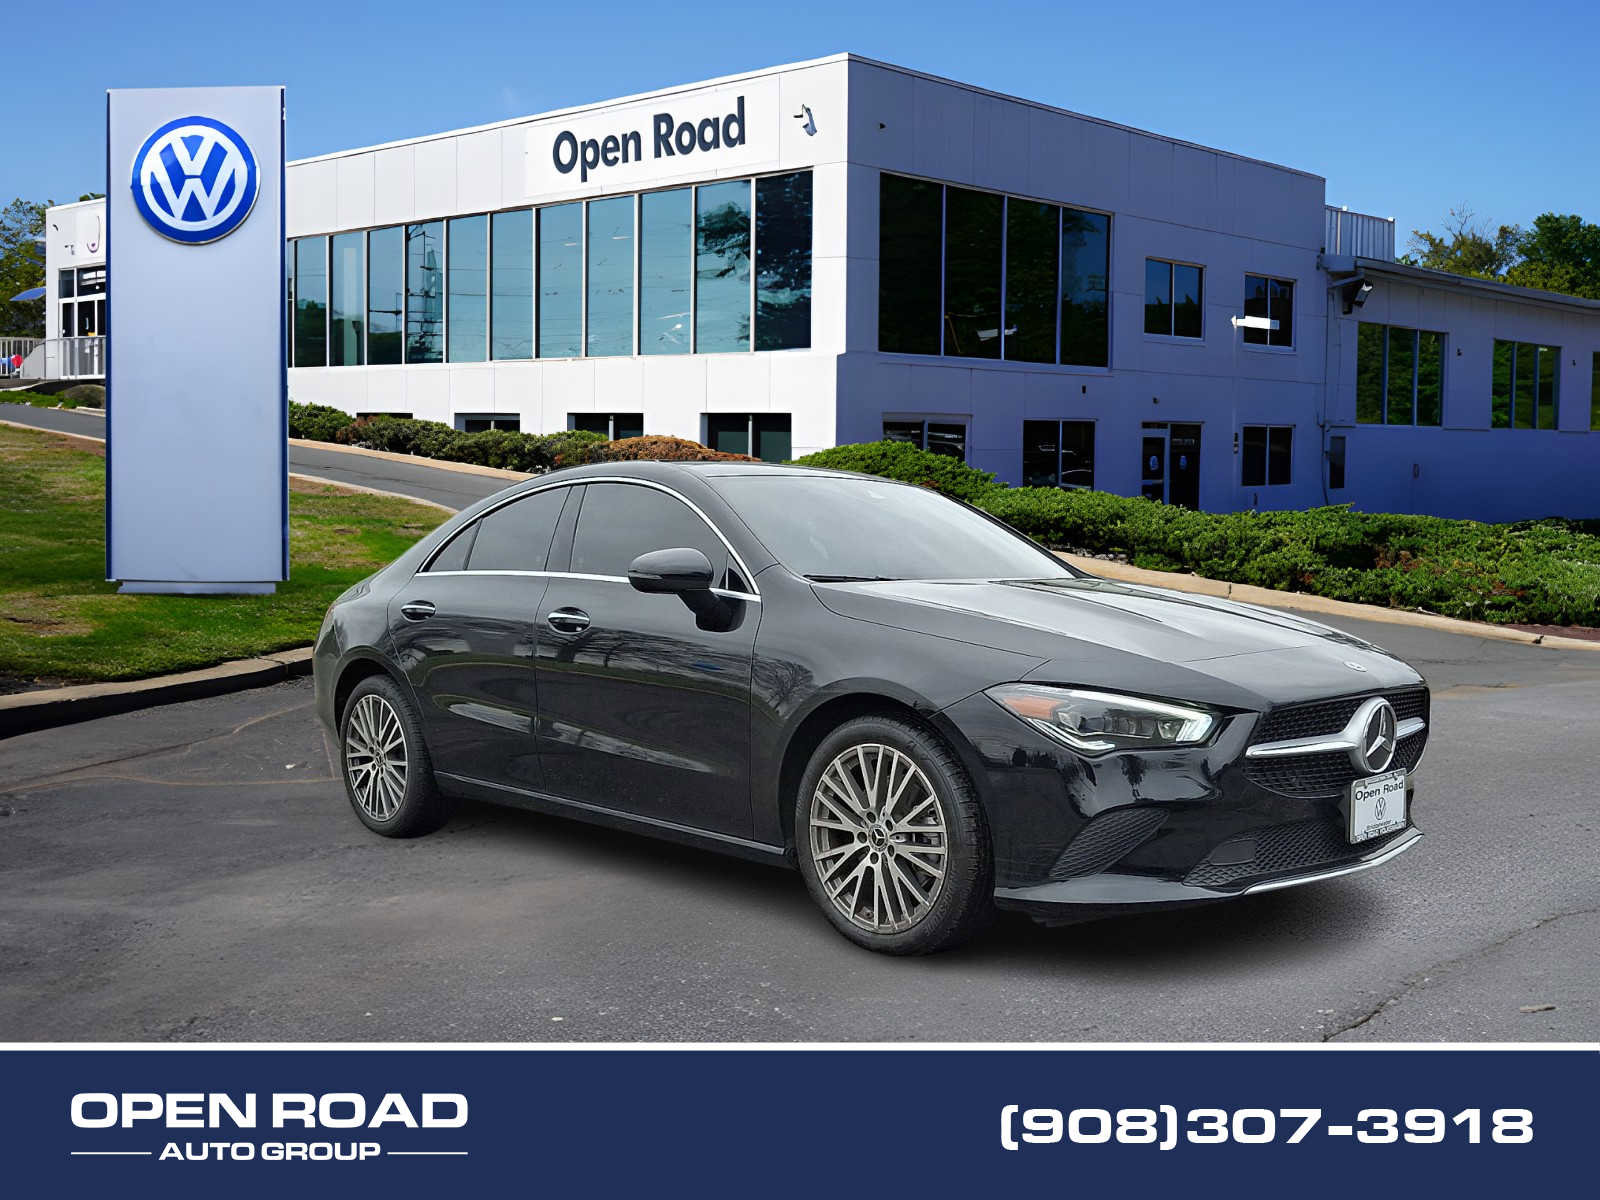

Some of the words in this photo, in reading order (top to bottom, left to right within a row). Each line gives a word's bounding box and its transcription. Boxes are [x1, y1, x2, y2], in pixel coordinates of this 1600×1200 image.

[553, 130, 642, 183] Open
[653, 95, 746, 159] Road
[1355, 788, 1380, 802] Open
[1383, 779, 1404, 794] Road
